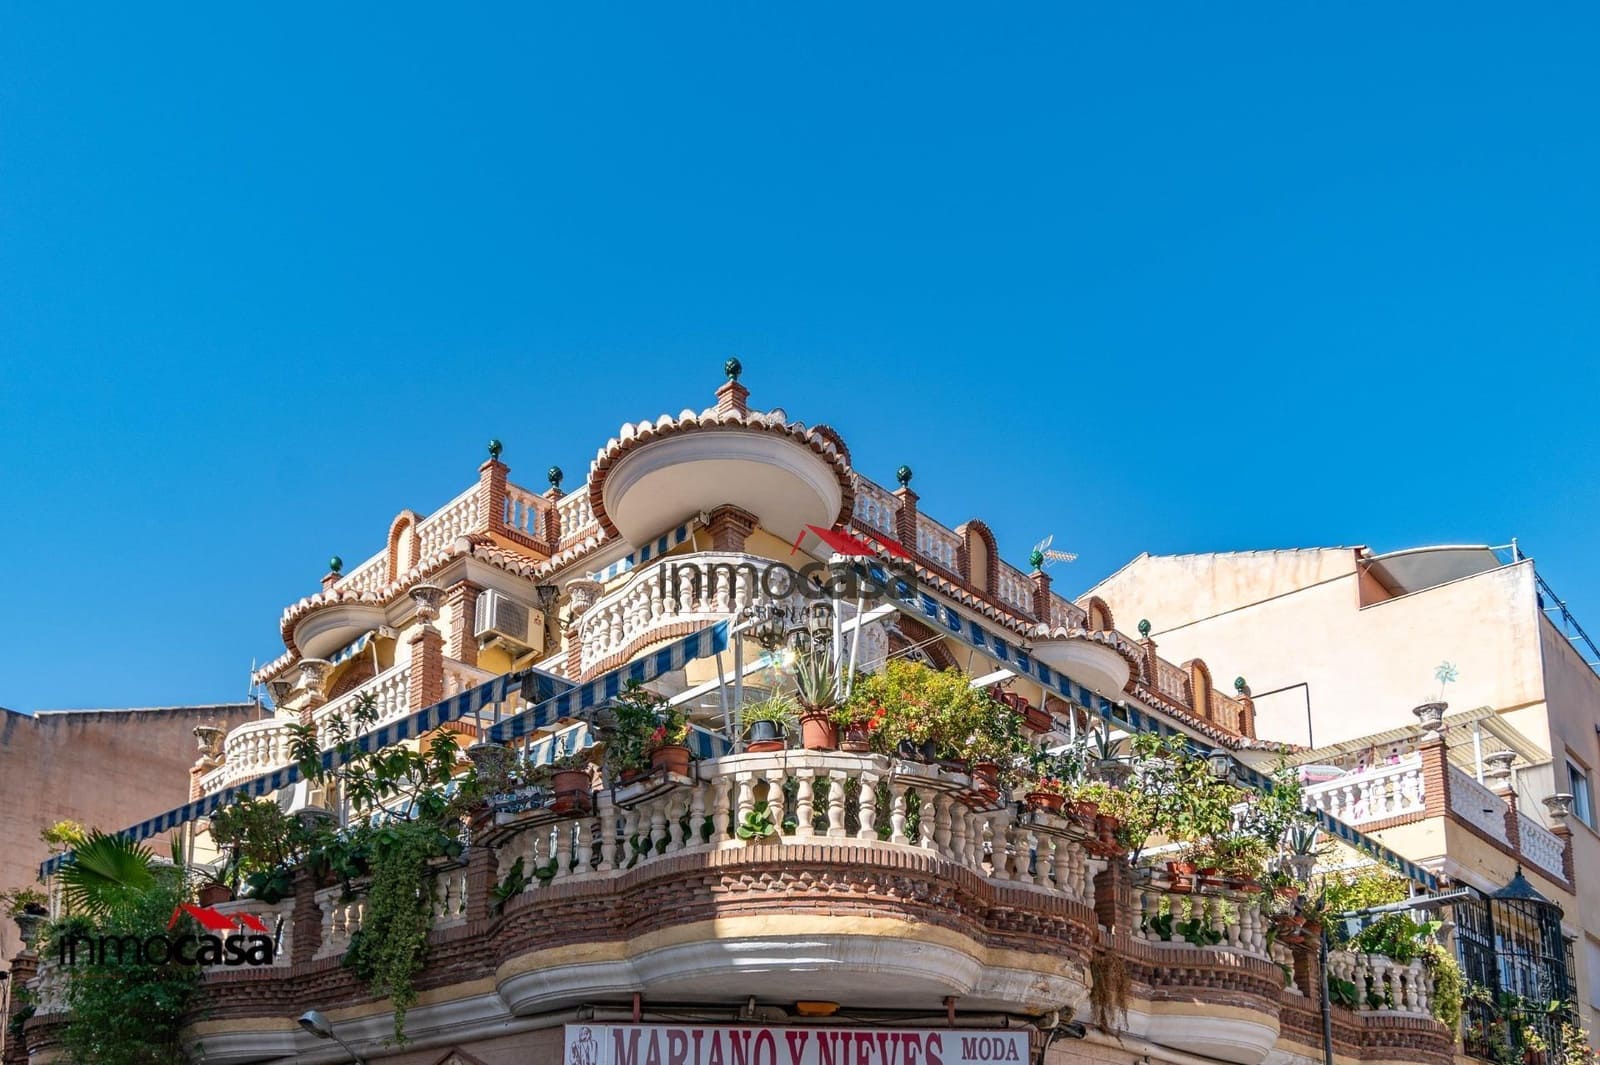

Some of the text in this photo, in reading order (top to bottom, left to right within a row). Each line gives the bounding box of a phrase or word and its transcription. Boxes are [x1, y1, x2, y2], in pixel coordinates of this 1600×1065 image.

[612, 1029, 1019, 1065] MARIANO Y NIEVES MODA
